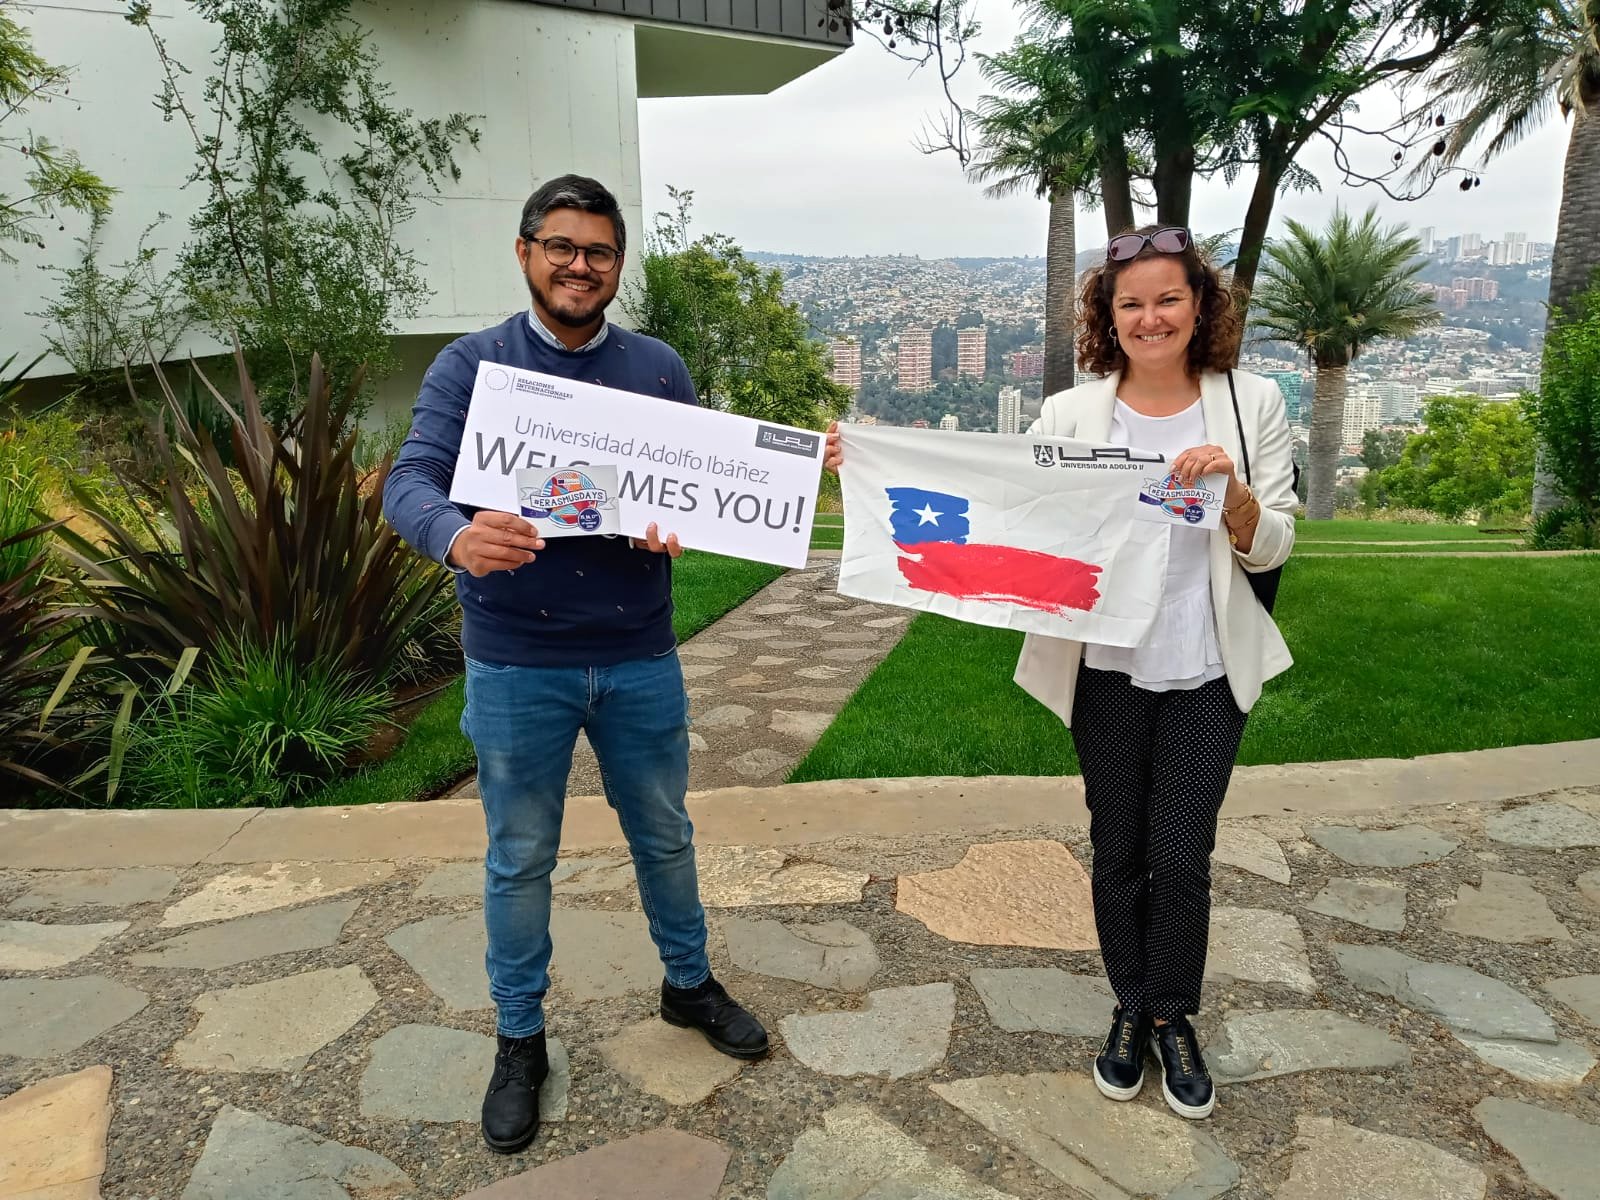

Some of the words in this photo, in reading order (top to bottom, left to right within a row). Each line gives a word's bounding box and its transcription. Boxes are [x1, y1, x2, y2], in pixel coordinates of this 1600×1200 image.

[516, 382, 574, 399] INTERNACIONALES
[517, 378, 555, 390] RELACIONES
[514, 415, 633, 457] Universidad
[637, 441, 702, 471] Adolfo
[706, 455, 771, 484] Ibáñez
[1060, 462, 1108, 470] UNIVERSIDAD
[1109, 463, 1138, 471] ADOLFO
[534, 491, 604, 507] #ERASMUSDAYS
[1151, 488, 1212, 501] #ERASMUSDAYS
[714, 488, 806, 534] YOU!
[1118, 1022, 1133, 1061] REPLAY
[1175, 1036, 1195, 1078] REPLAY
